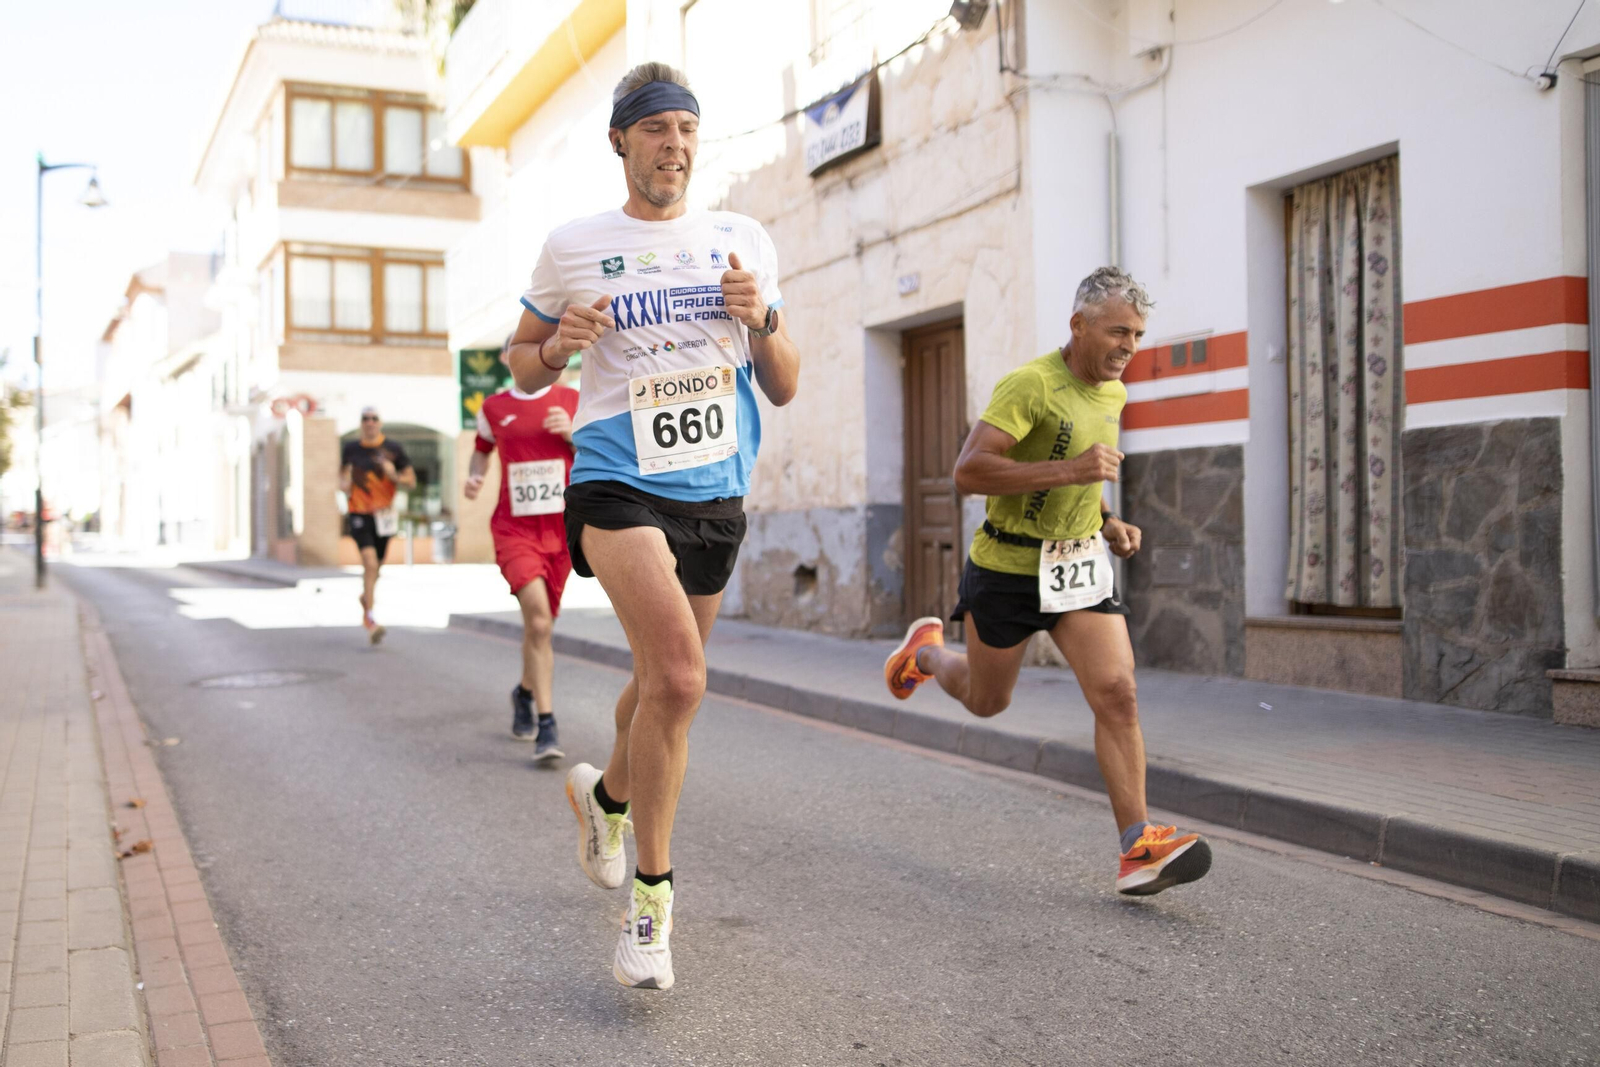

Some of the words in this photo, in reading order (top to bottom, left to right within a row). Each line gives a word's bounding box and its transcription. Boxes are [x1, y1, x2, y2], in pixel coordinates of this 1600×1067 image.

[611, 288, 670, 332] XXXVI
[673, 296, 725, 310] PRUEB
[675, 313, 692, 322] DE
[654, 375, 718, 398] FONDO
[677, 370, 706, 380] PREMIO
[652, 403, 723, 448] 660
[1024, 416, 1074, 521] PANERDE
[514, 482, 562, 503] 3024
[1049, 559, 1096, 592] 327
